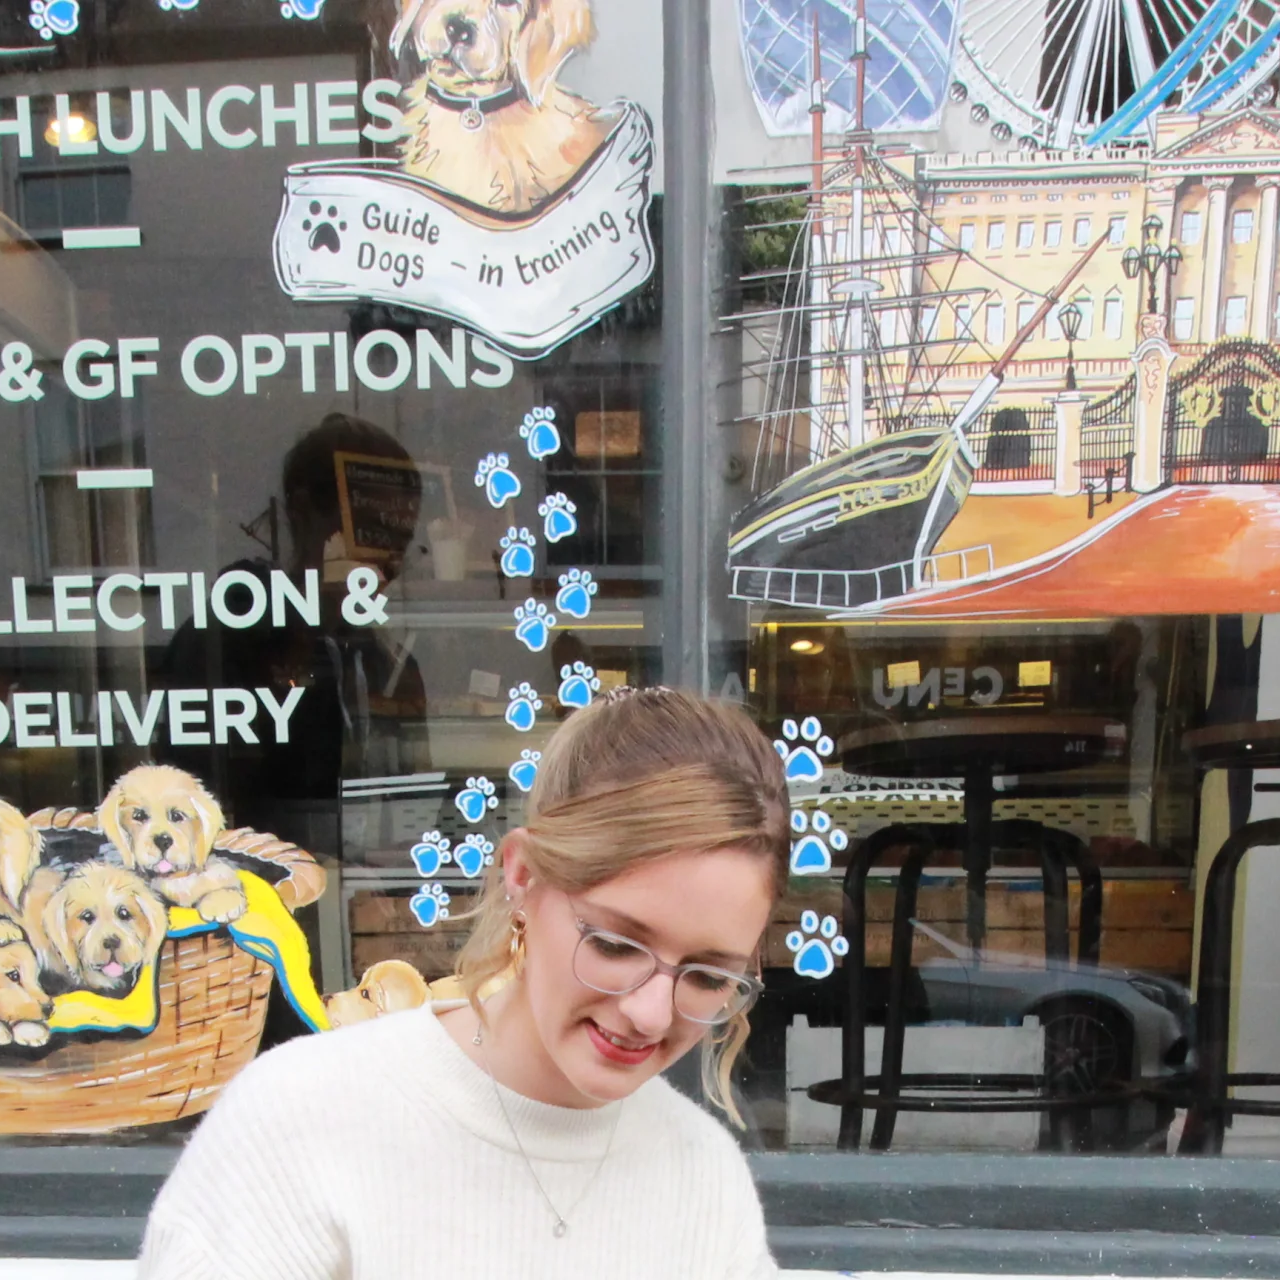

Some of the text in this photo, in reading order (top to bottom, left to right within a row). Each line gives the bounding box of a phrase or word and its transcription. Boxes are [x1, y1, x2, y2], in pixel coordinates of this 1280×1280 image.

[58, 80, 404, 154] LUNCHES
[356, 242, 426, 288] Dogs
[478, 252, 504, 287] in
[517, 207, 623, 285] training
[361, 202, 440, 246] Guide
[62, 337, 160, 400] GF
[180, 329, 514, 396] OPTIONS
[342, 566, 391, 627] &
